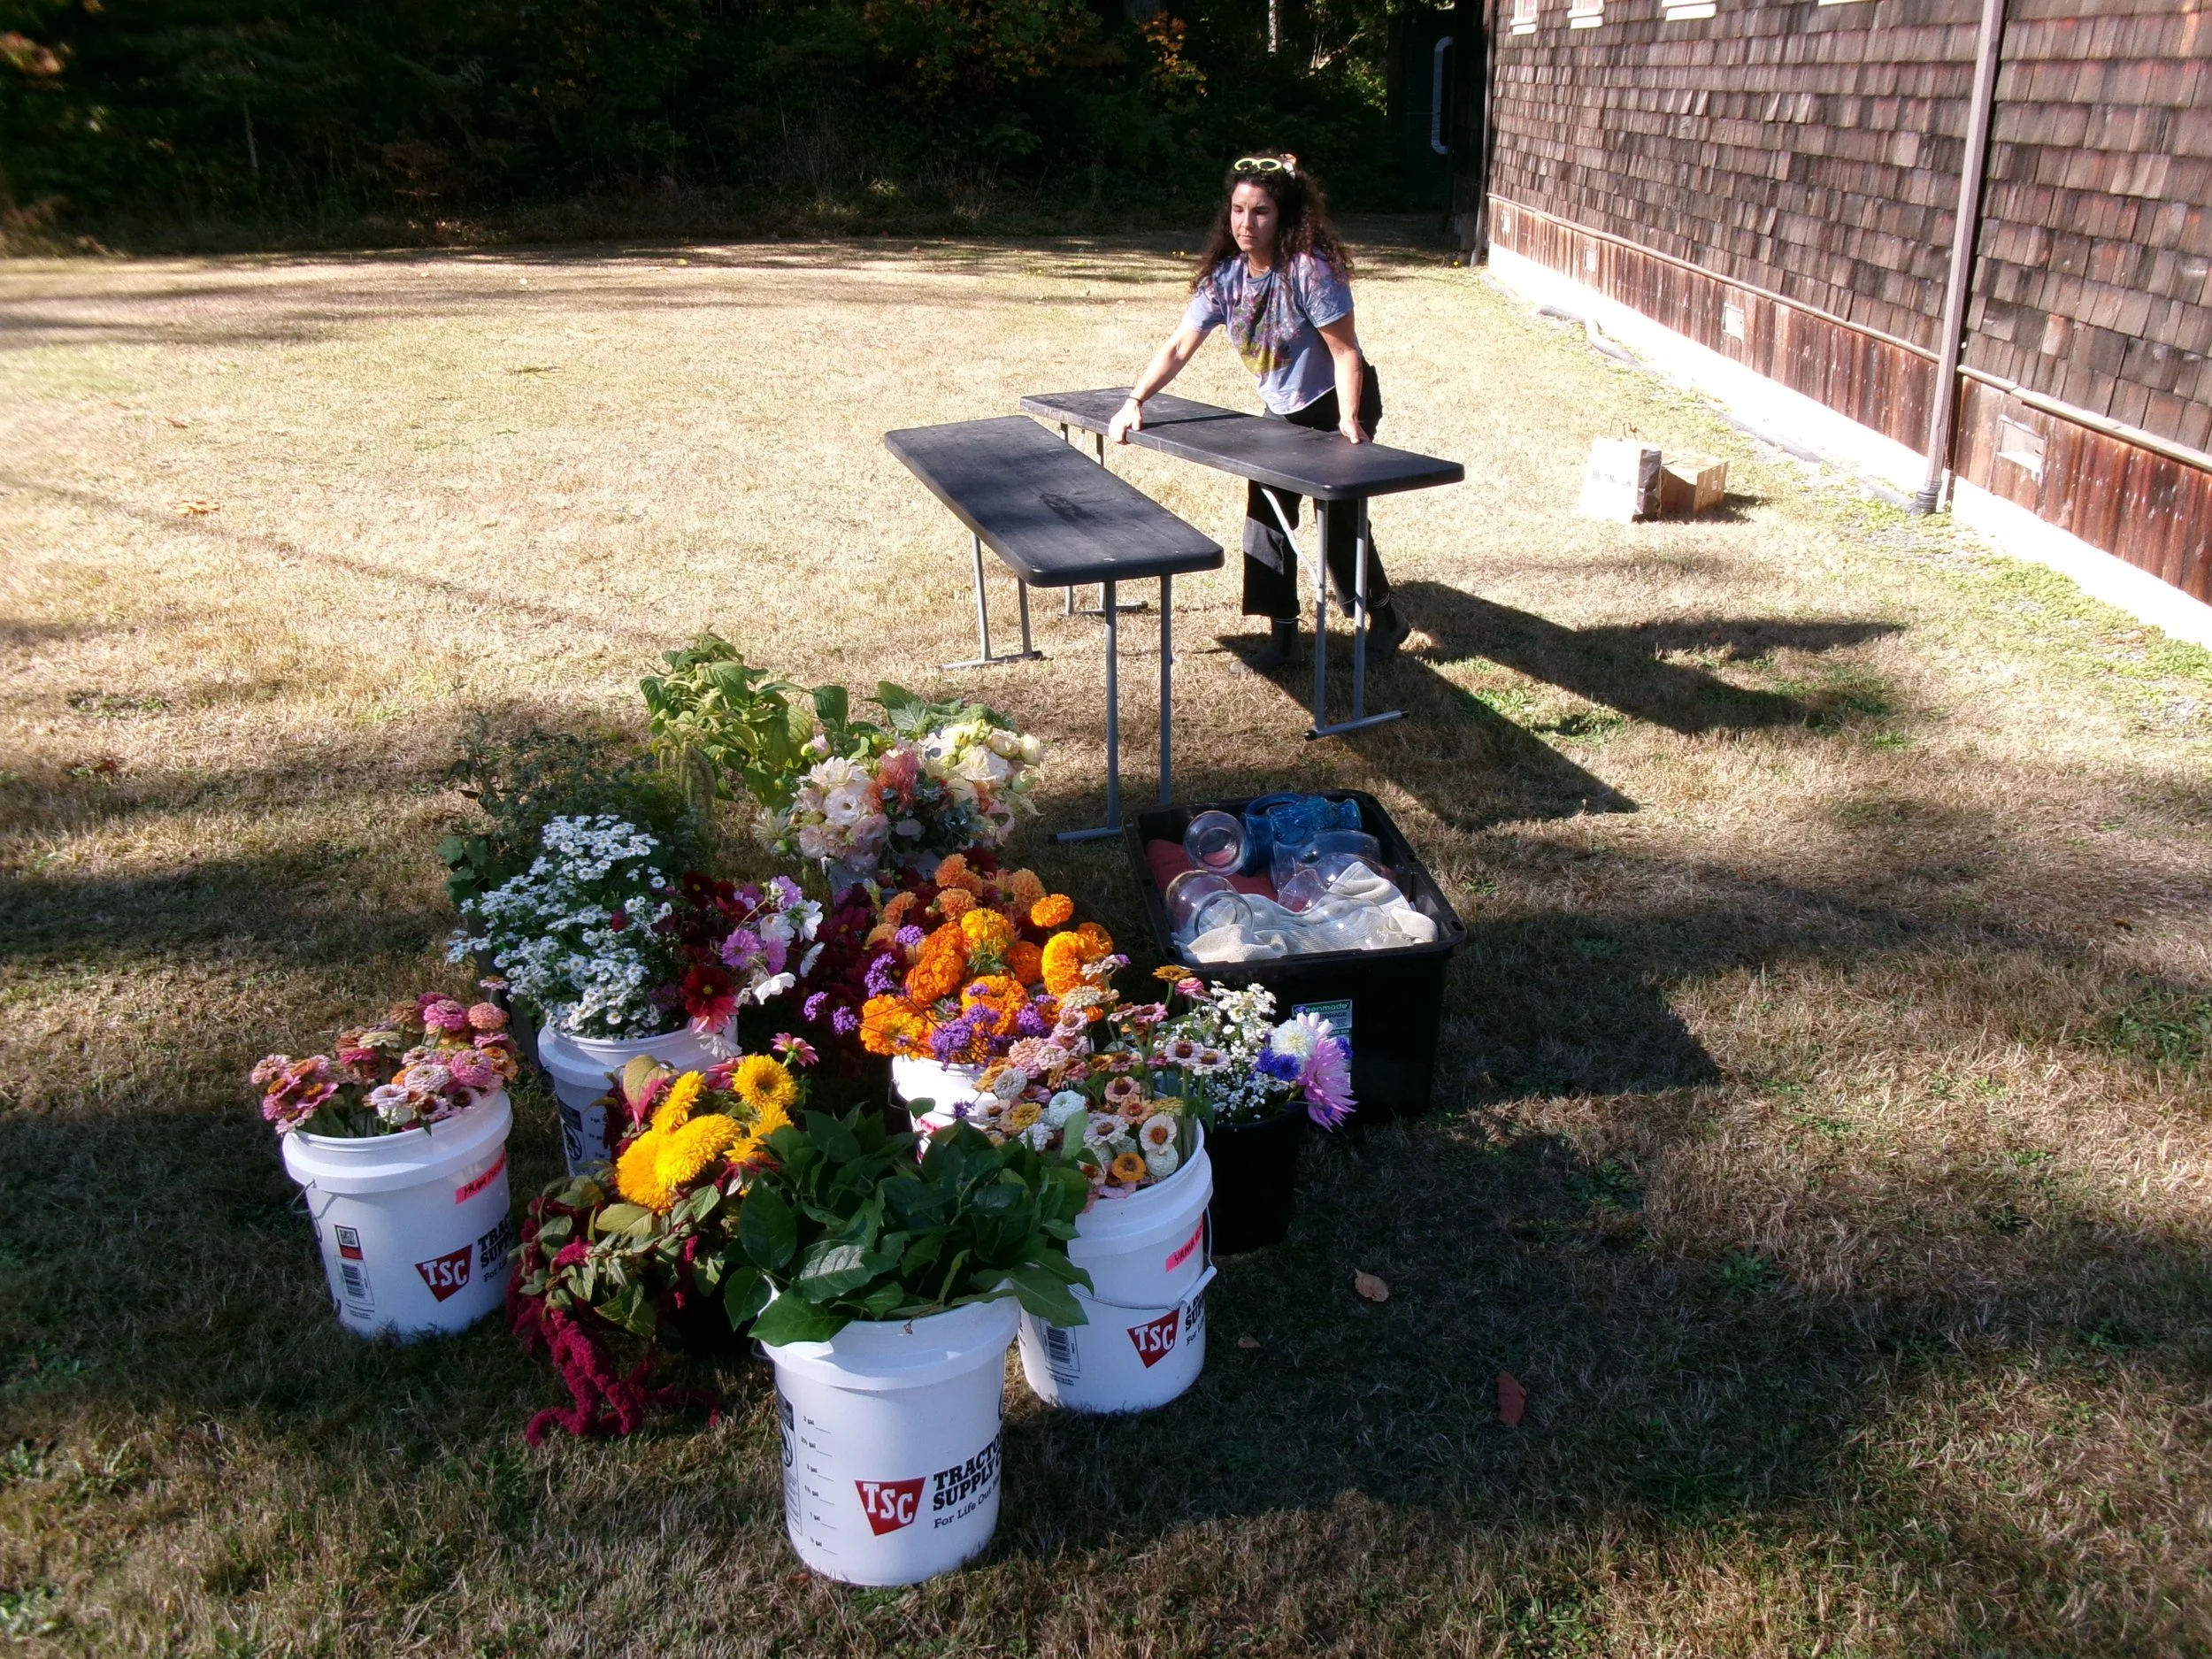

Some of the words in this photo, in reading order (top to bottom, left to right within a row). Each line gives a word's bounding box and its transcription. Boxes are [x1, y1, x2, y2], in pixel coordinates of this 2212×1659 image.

[1295, 1002, 1348, 1014] eenmade
[1319, 1010, 1347, 1019] TORAGE
[423, 1261, 468, 1286] TSC
[1134, 1324, 1174, 1352] TSC
[933, 1430, 1002, 1491] TRACTO
[933, 1456, 995, 1511] SUPPLY
[863, 1483, 913, 1524] TSC
[934, 1515, 955, 1529] For
[957, 1502, 977, 1519] Life
[978, 1488, 992, 1505] Out
